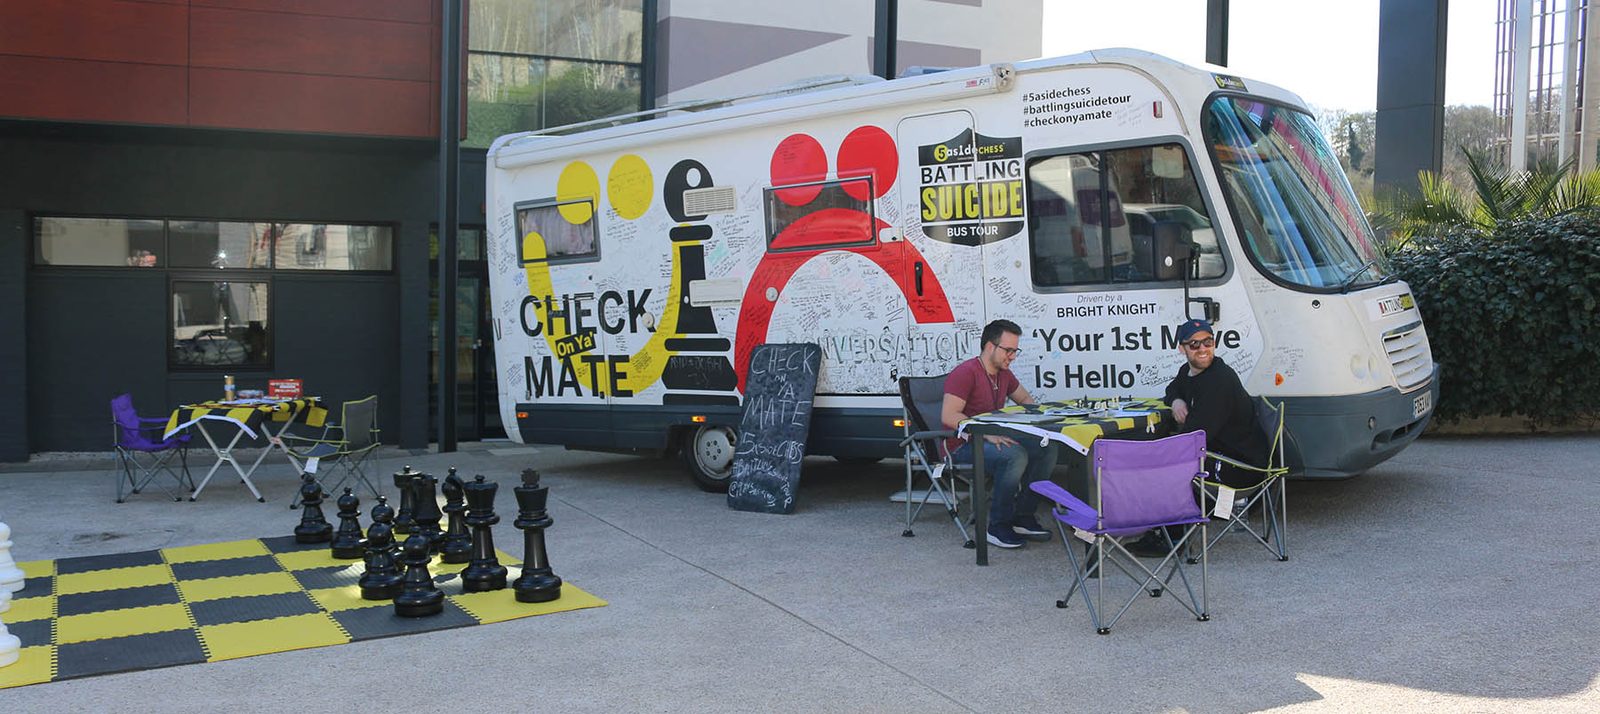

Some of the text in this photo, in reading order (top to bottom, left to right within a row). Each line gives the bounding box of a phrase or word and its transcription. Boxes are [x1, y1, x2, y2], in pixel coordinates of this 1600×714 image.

[1022, 86, 1091, 102] #5asidechess
[1023, 94, 1132, 115] #battlingsuicidetour
[1024, 110, 1112, 127] #checkonyamate
[922, 181, 1023, 221] SUICIDE
[947, 225, 999, 237] BUS TOUR
[1057, 303, 1156, 318] BRIGHT KNIGHT
[1077, 294, 1103, 303] Driven
[1104, 294, 1114, 303] by
[519, 288, 657, 337] CHECK
[557, 331, 593, 356] On Ya'
[1111, 326, 1152, 351] 1st
[1161, 325, 1240, 350] Mve
[751, 347, 815, 375] CHECK
[524, 355, 633, 398] MATE
[1035, 365, 1057, 389] Is
[777, 383, 795, 399] YA
[742, 395, 812, 430] MATE
